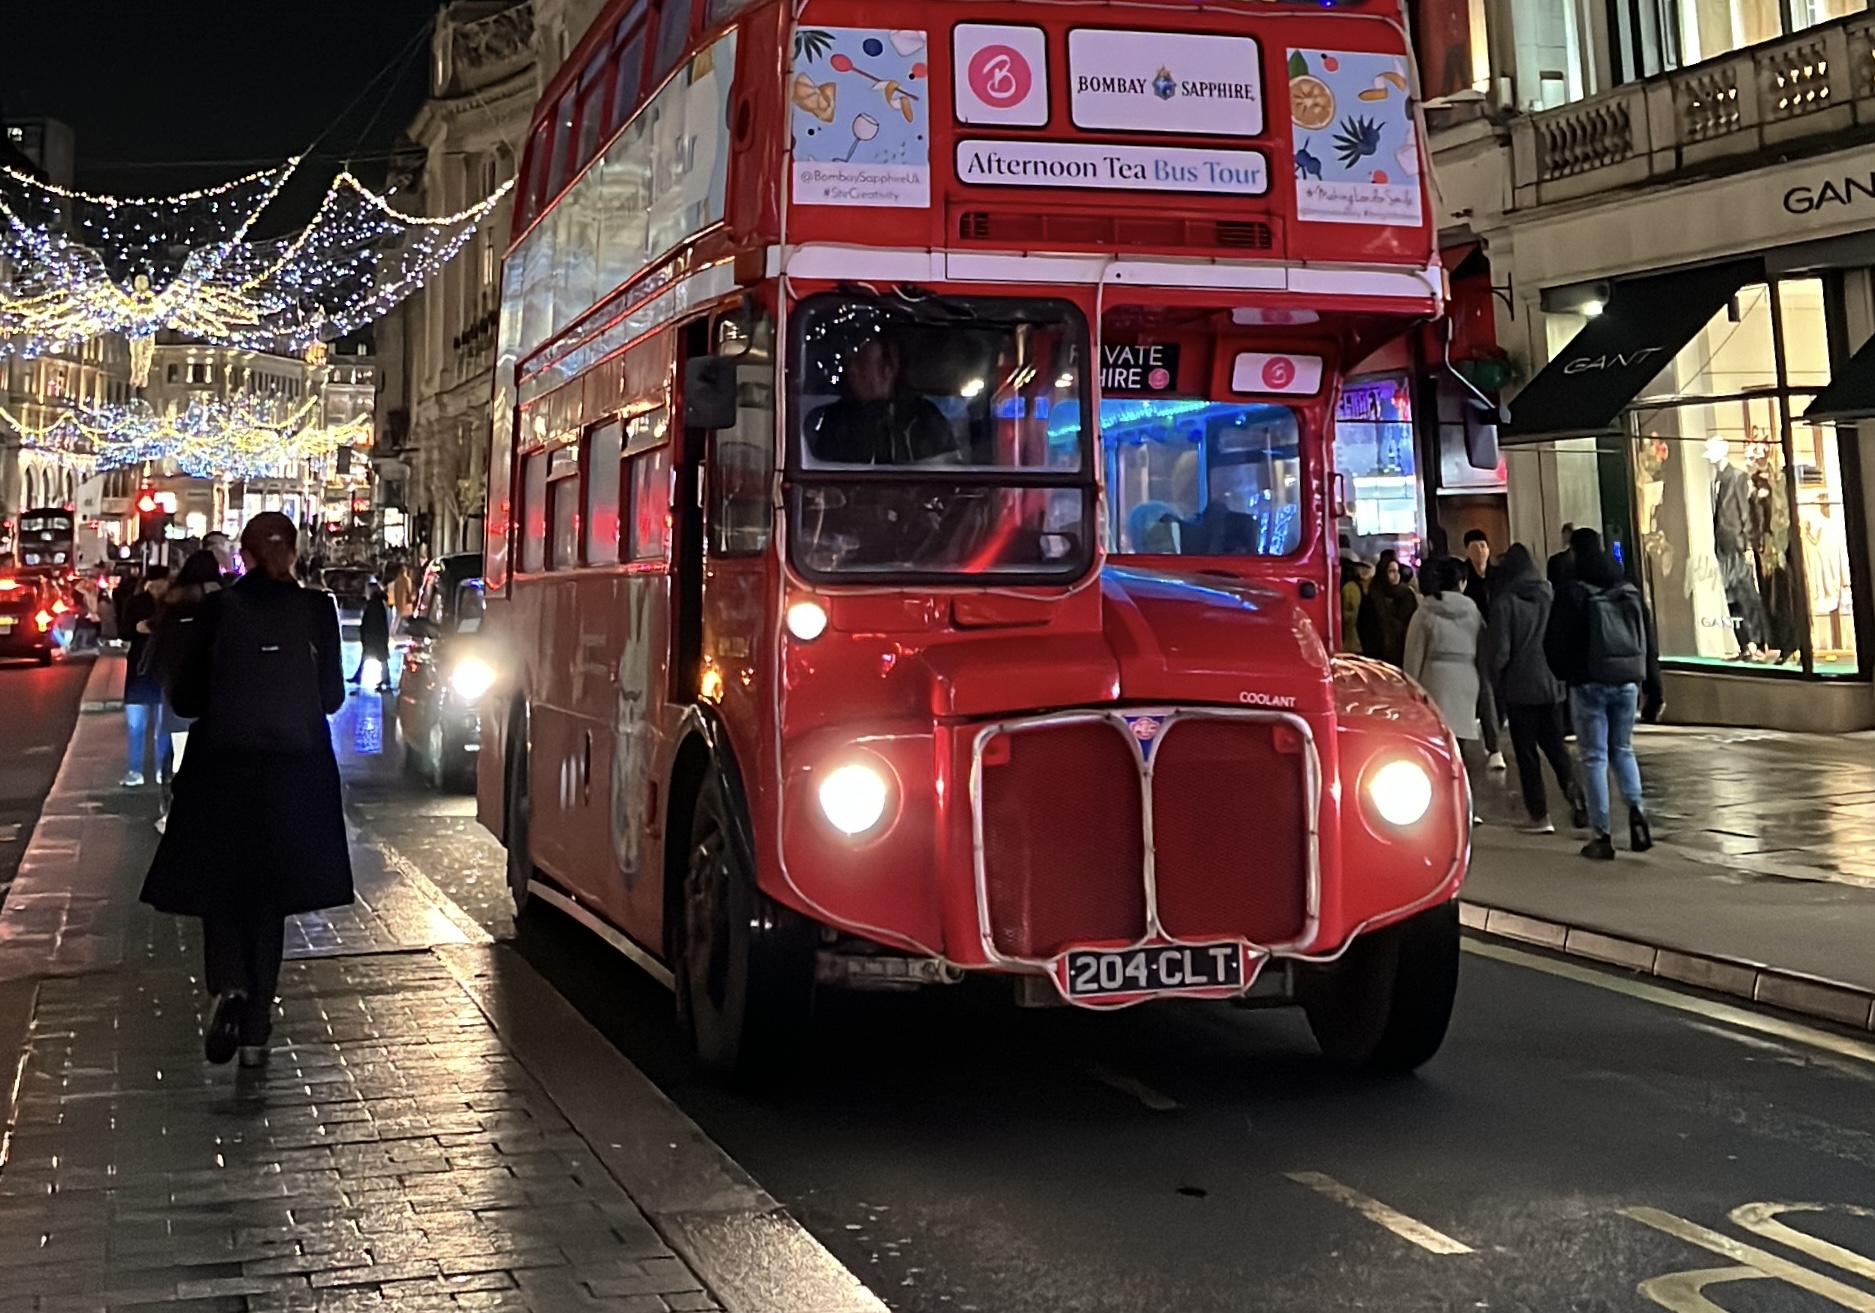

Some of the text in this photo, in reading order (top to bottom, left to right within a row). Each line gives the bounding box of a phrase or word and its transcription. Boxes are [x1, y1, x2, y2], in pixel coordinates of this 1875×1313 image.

[1077, 75, 1255, 102] BOMBAY SAPPHIRE
[968, 151, 1261, 185] Afternoon Tea Bus Tour
[1563, 346, 1664, 375] GANT
[1701, 616, 1744, 630] GANT
[1239, 691, 1296, 708] COOLANT
[1075, 947, 1232, 992] 204 CLT
